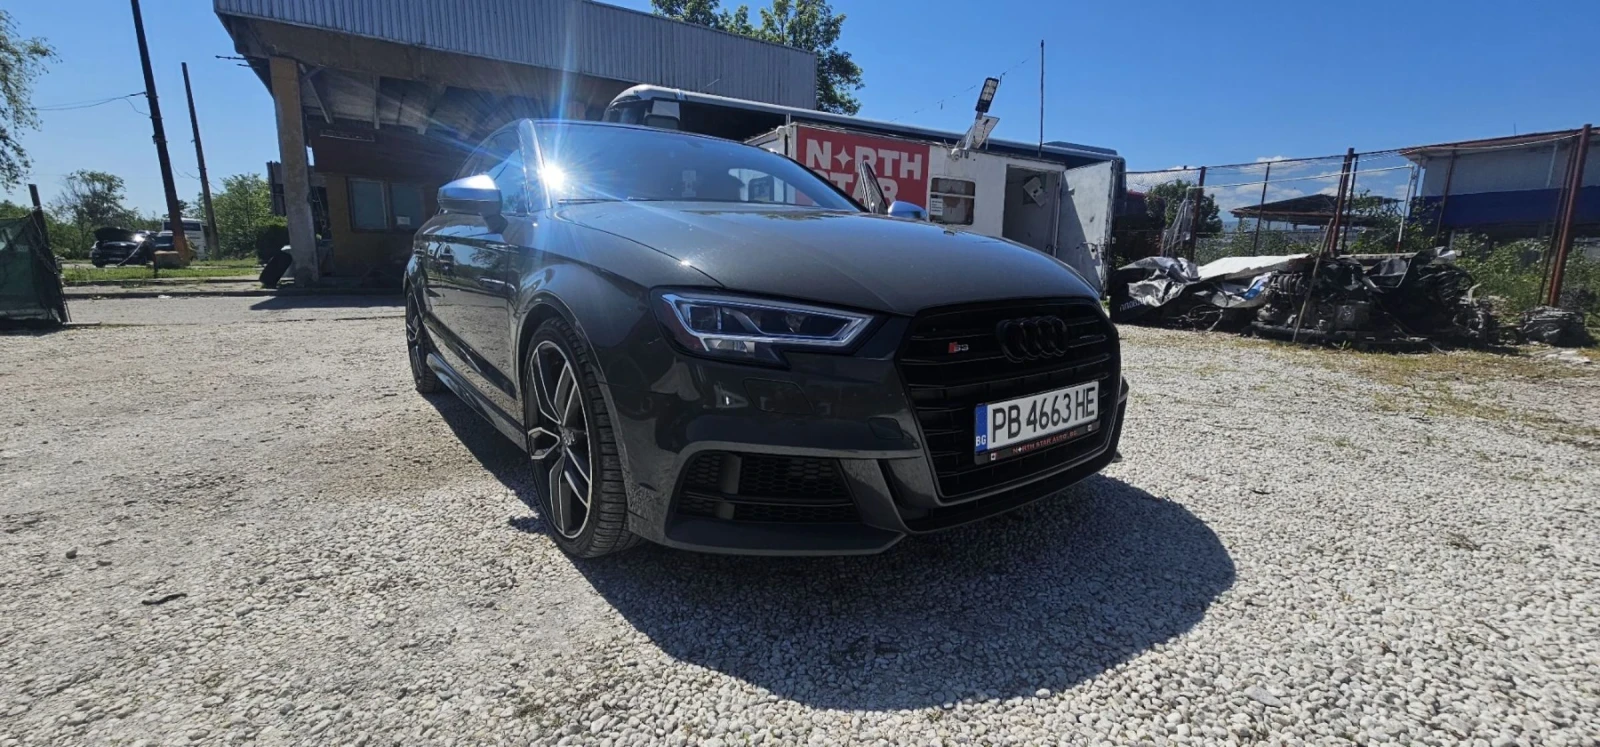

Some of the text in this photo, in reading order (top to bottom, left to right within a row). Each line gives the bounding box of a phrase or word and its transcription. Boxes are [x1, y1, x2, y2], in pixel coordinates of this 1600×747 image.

[992, 386, 1096, 443] PB 4663 HE
[975, 434, 987, 447] BG
